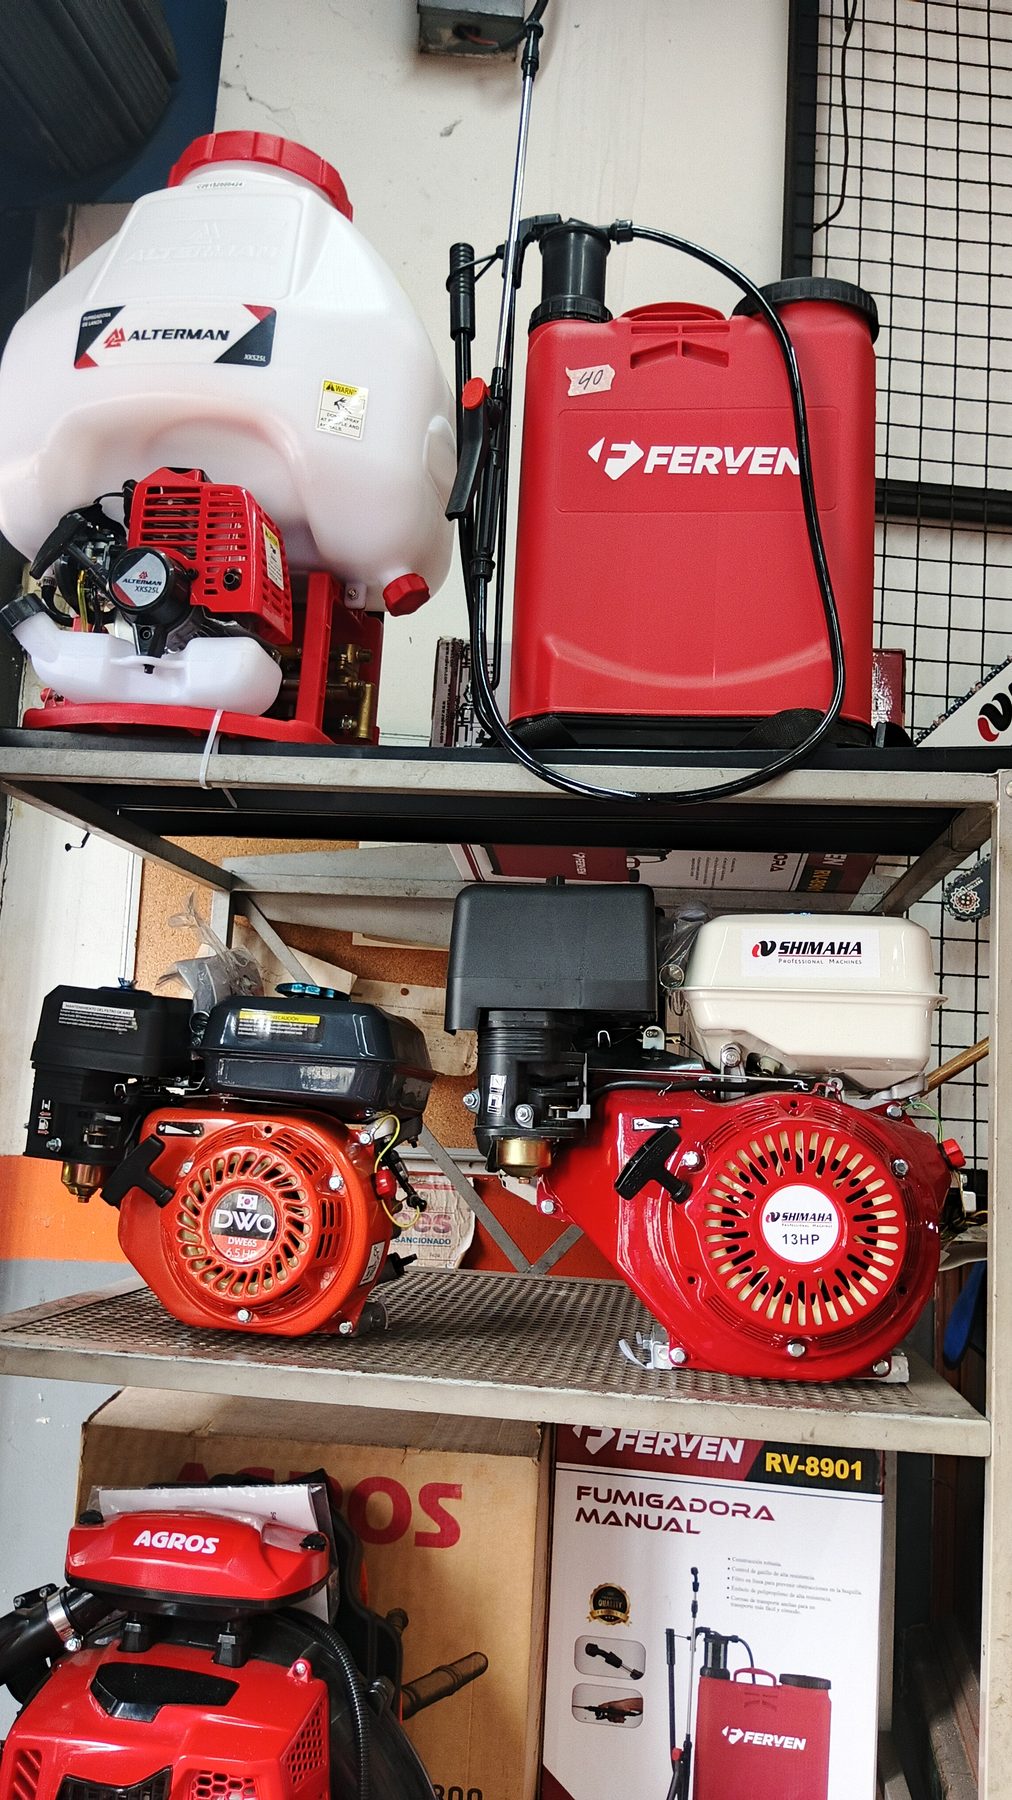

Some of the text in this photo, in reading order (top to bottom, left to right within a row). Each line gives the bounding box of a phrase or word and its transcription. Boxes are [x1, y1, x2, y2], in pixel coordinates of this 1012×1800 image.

[127, 328, 230, 342] ALTERMAN
[578, 369, 604, 390] 40
[643, 446, 800, 475] FERVEN
[122, 578, 162, 587] ALTERMAN
[134, 586, 160, 594] XKS25L
[777, 941, 862, 955] SHIMAHA
[214, 1209, 275, 1233] DWO
[781, 1212, 832, 1222] SHIMAHA
[227, 1236, 257, 1247] DWE65
[226, 1247, 240, 1258] 6.5
[616, 1429, 744, 1464] FERVEN
[765, 1452, 862, 1480] RV-8901
[576, 1485, 775, 1521] FUMIGADORA
[575, 1507, 701, 1534] MANUAL
[134, 1530, 219, 1554] AGROS
[743, 1731, 807, 1750] FERVEN
